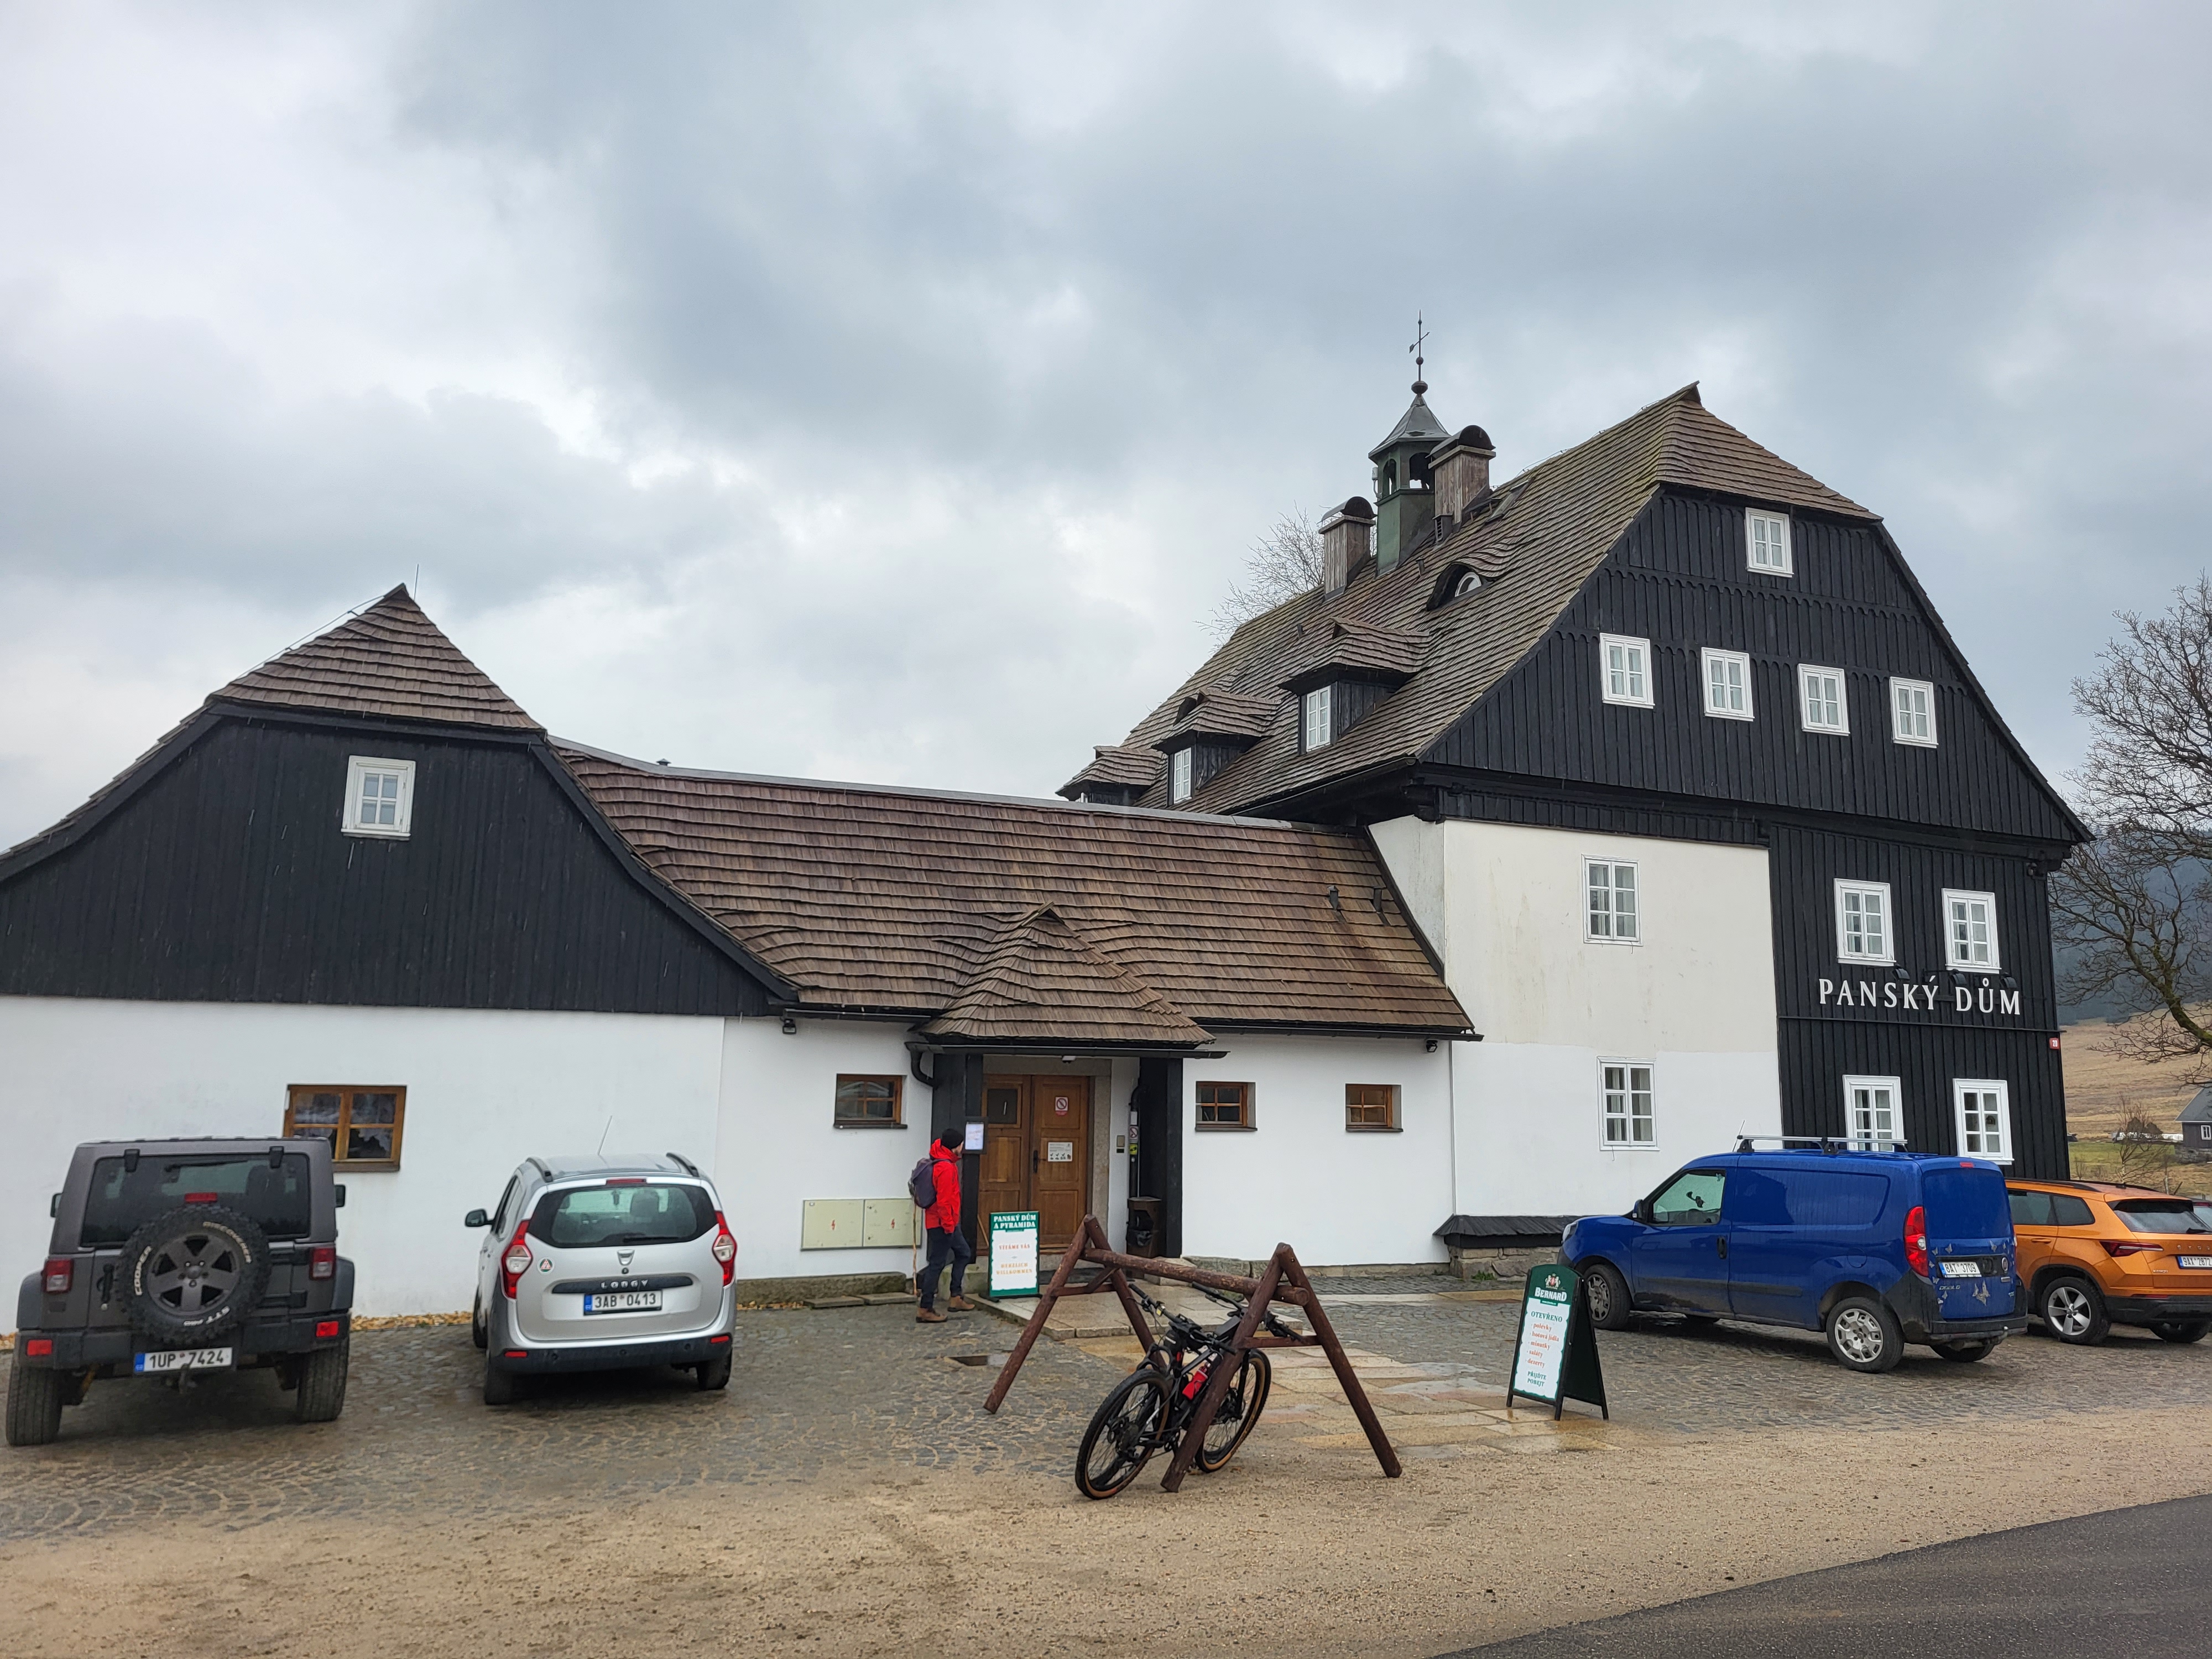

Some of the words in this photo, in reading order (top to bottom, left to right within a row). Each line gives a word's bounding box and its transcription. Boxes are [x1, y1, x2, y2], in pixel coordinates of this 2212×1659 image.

[1819, 975, 1938, 1010] PANSKÝ
[1955, 978, 2020, 1015] DŮM
[993, 1214, 1020, 1222] PANSKÝ
[1021, 1212, 1036, 1221] DŮM
[202, 1221, 252, 1263] DISCOVERER
[2183, 1257, 2194, 1266] 9AX
[2197, 1257, 2212, 1266] 2872
[134, 1245, 152, 1295] COOPER
[1944, 1263, 1958, 1273] 8AT
[1960, 1263, 1976, 1273] 3709
[601, 1279, 649, 1289] LODGY
[1535, 1287, 1567, 1302] BERNARD
[594, 1295, 617, 1308] 3AB
[627, 1293, 656, 1306] 0413
[1531, 1311, 1563, 1322] OTEVŘENO
[1531, 1340, 1550, 1350] minutky
[149, 1354, 176, 1369] 1UP
[189, 1350, 223, 1366] 7424
[1527, 1358, 1545, 1368] dezerty
